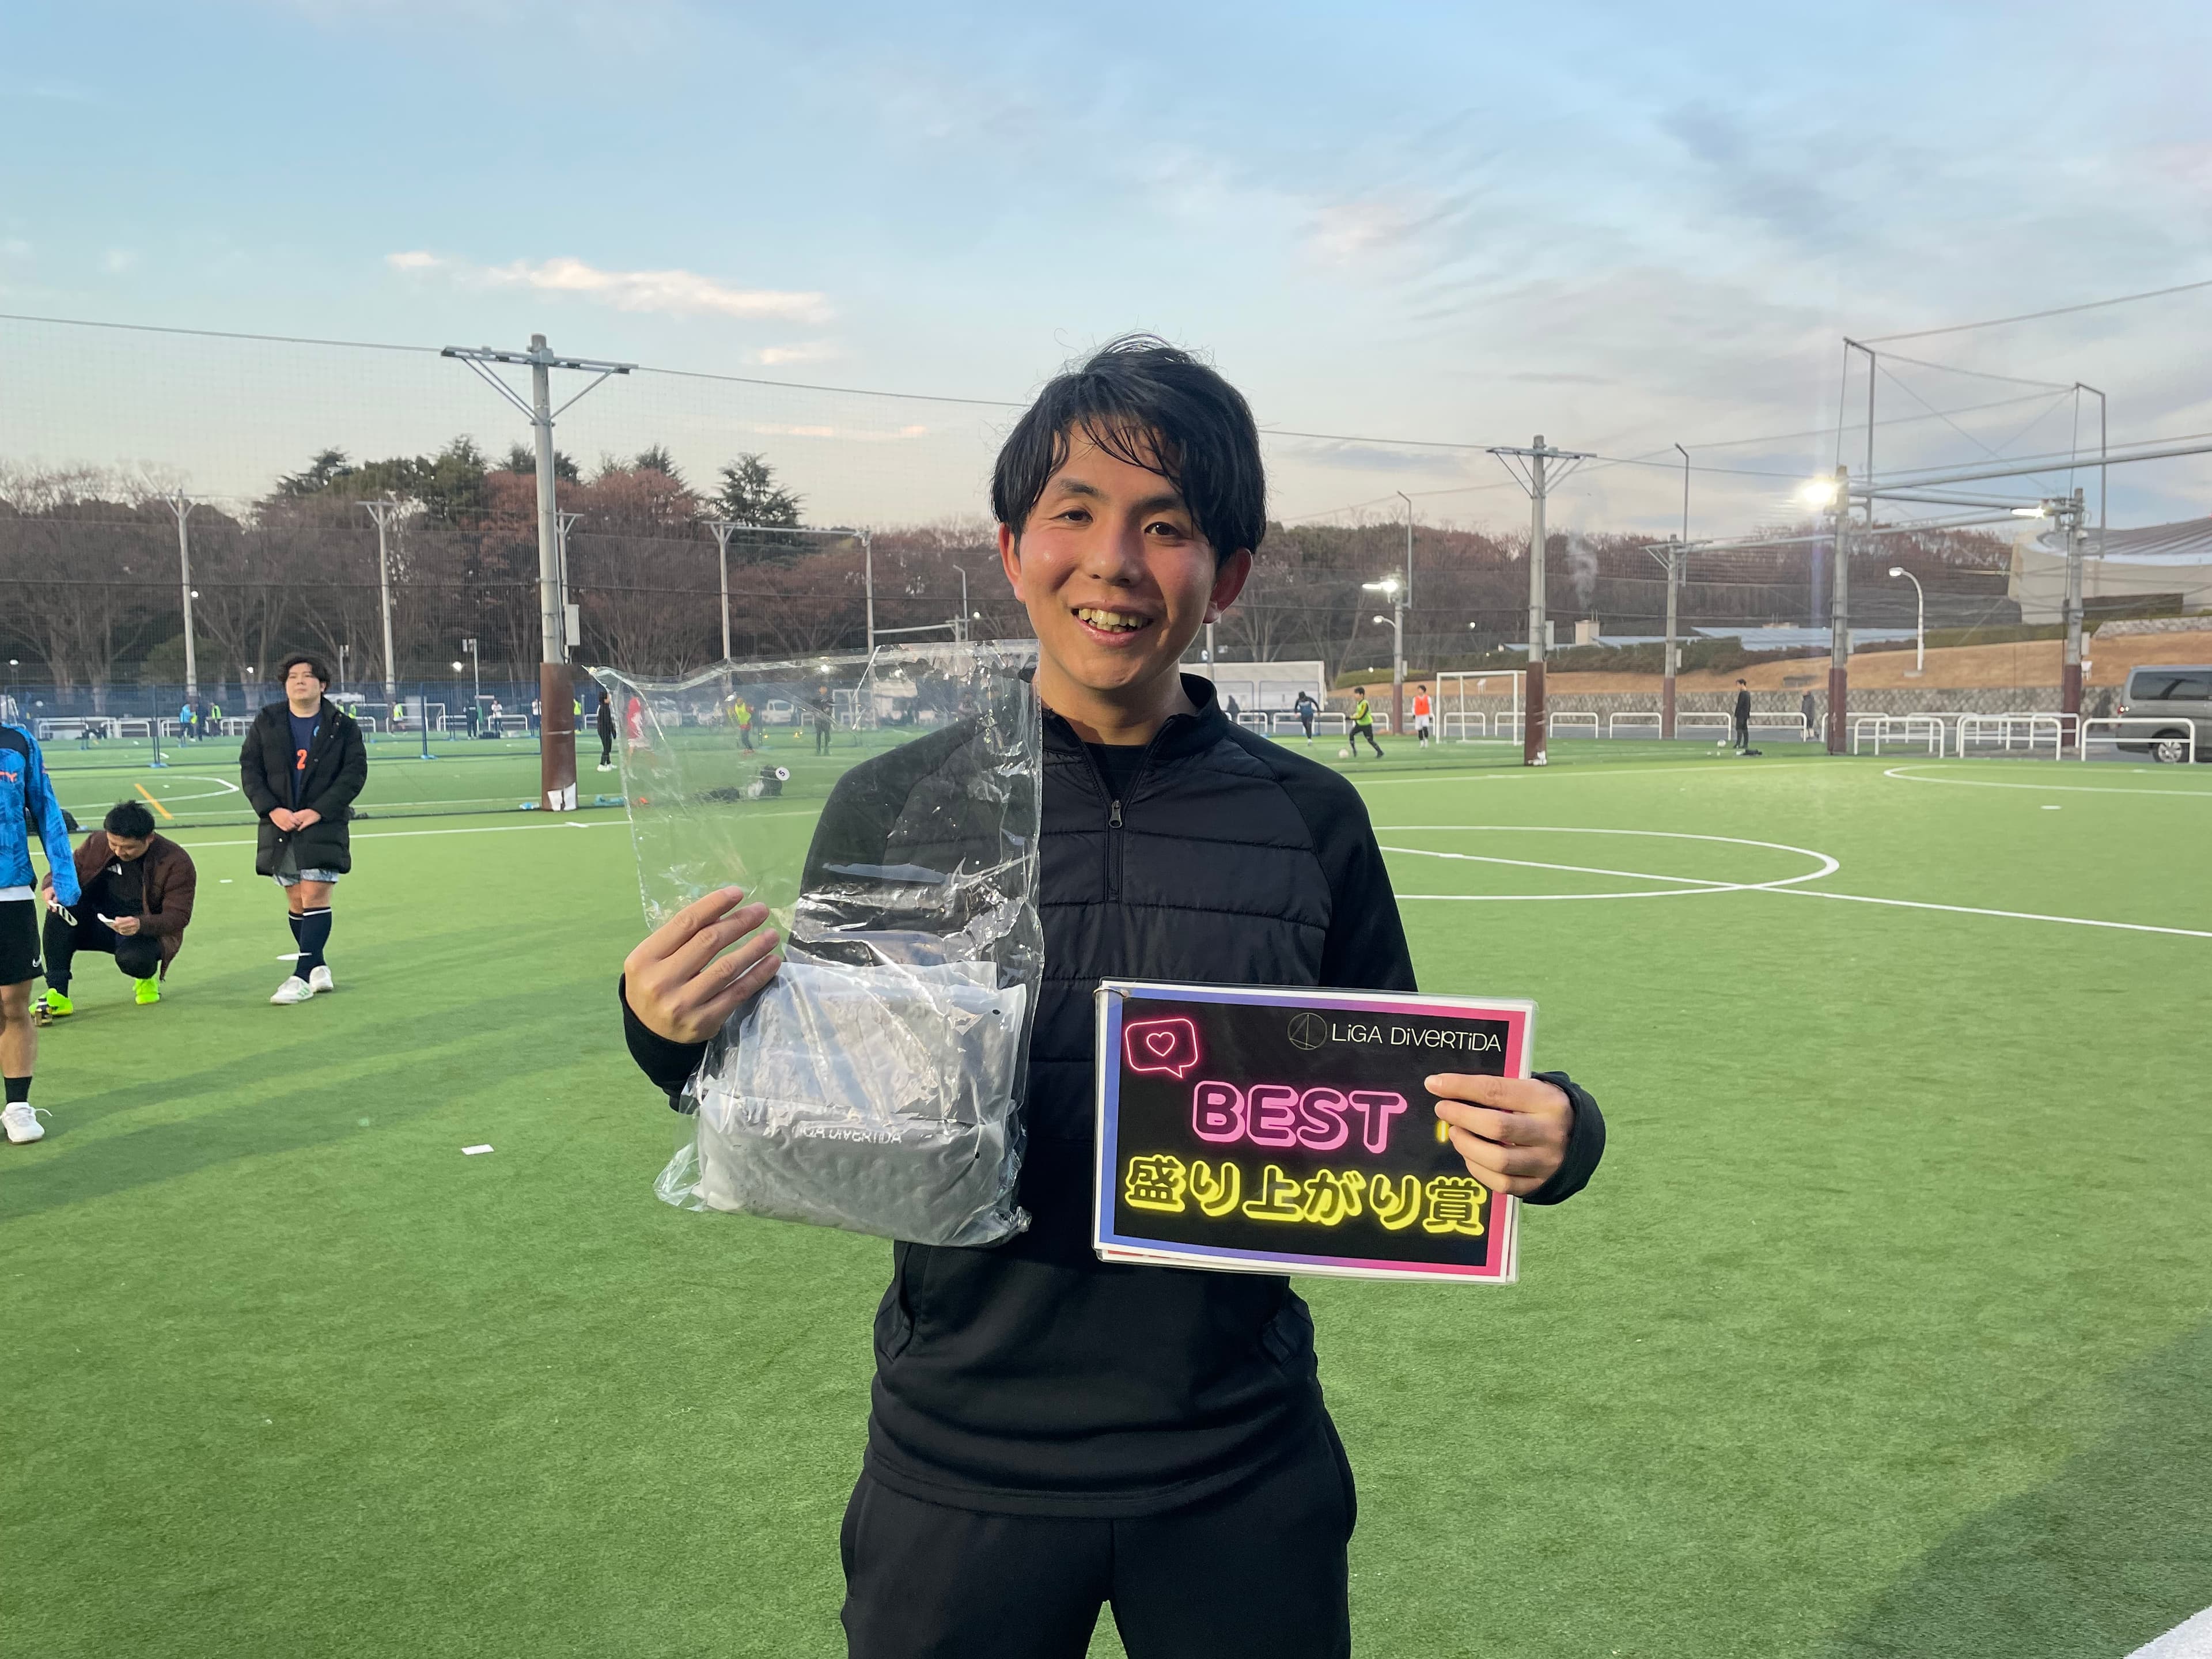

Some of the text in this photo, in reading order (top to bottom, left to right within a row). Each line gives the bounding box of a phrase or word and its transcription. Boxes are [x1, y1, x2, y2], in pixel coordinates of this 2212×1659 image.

[297, 749, 308, 770] 2
[1192, 1080, 1407, 1154] BEST
[1124, 1154, 1487, 1236] 盛り上がり賞
